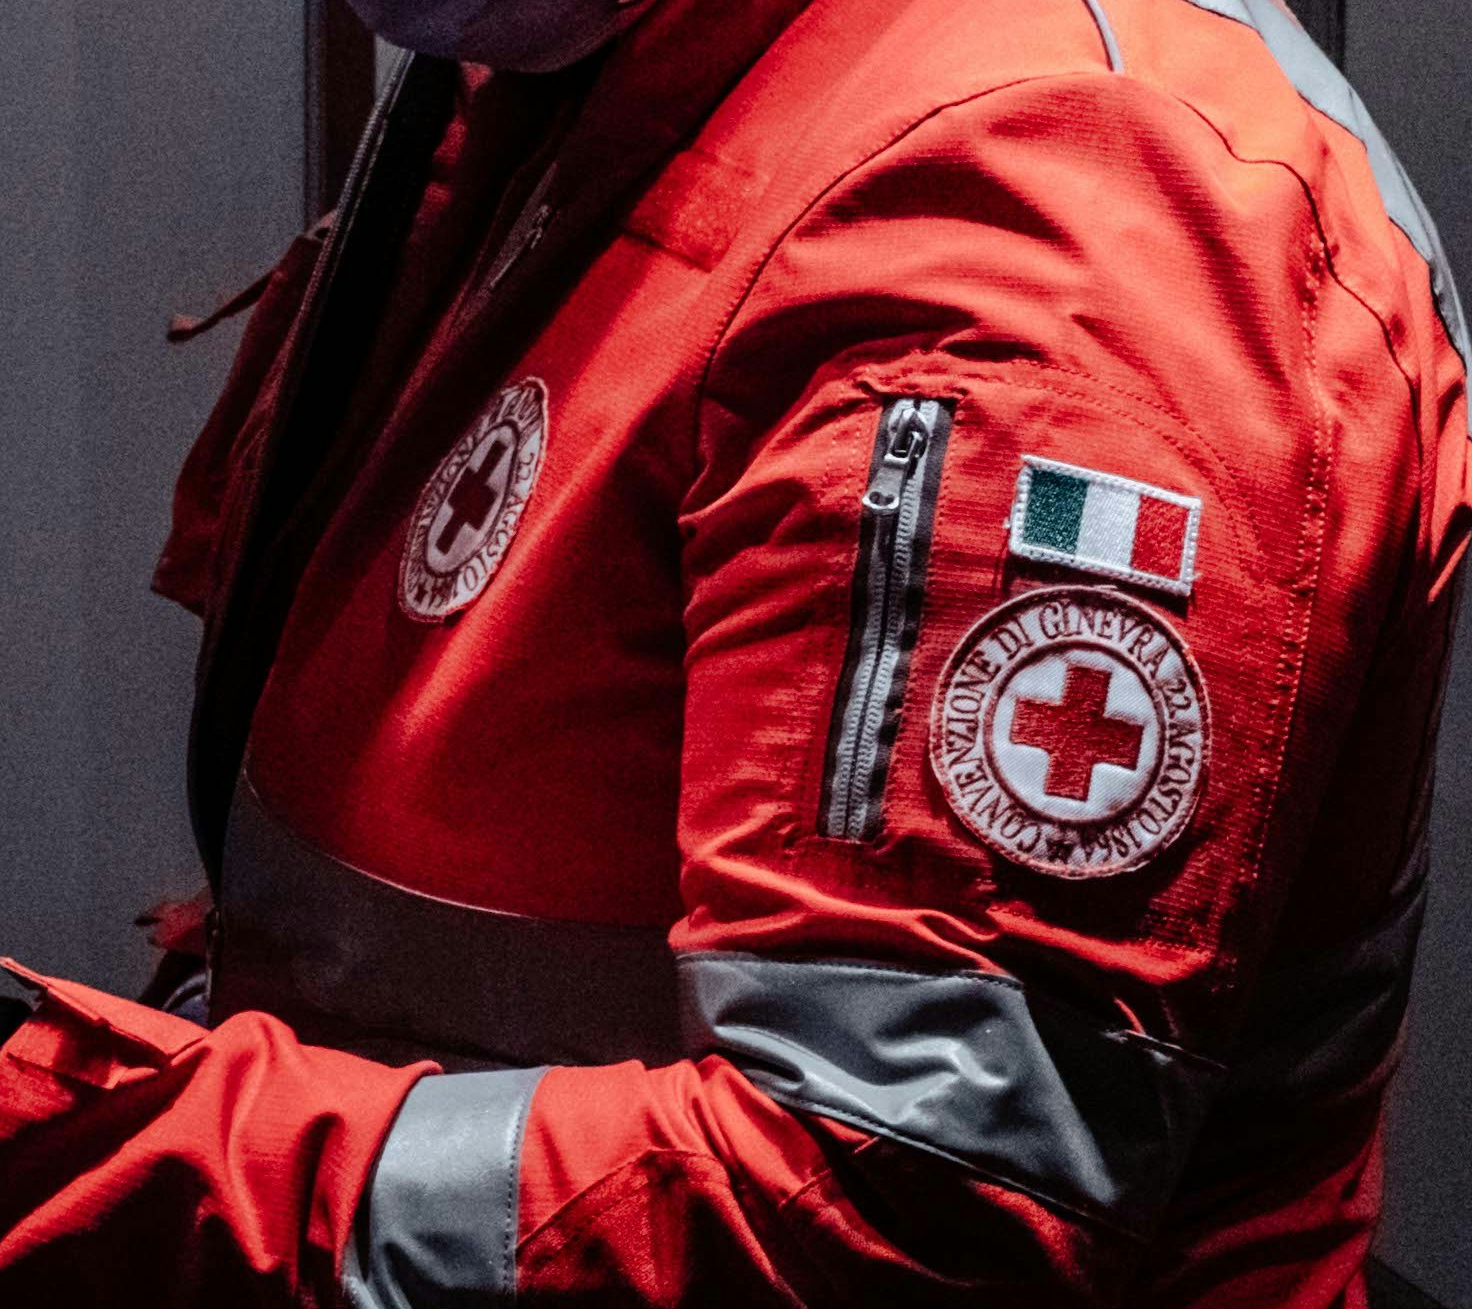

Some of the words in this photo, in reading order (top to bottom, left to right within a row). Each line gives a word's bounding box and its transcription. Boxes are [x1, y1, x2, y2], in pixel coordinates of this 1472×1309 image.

[992, 619, 1035, 660] DI
[1038, 600, 1170, 679] GINEVRA
[944, 652, 1042, 855] CONVENZIONE
[1136, 721, 1199, 835] AGOSTO
